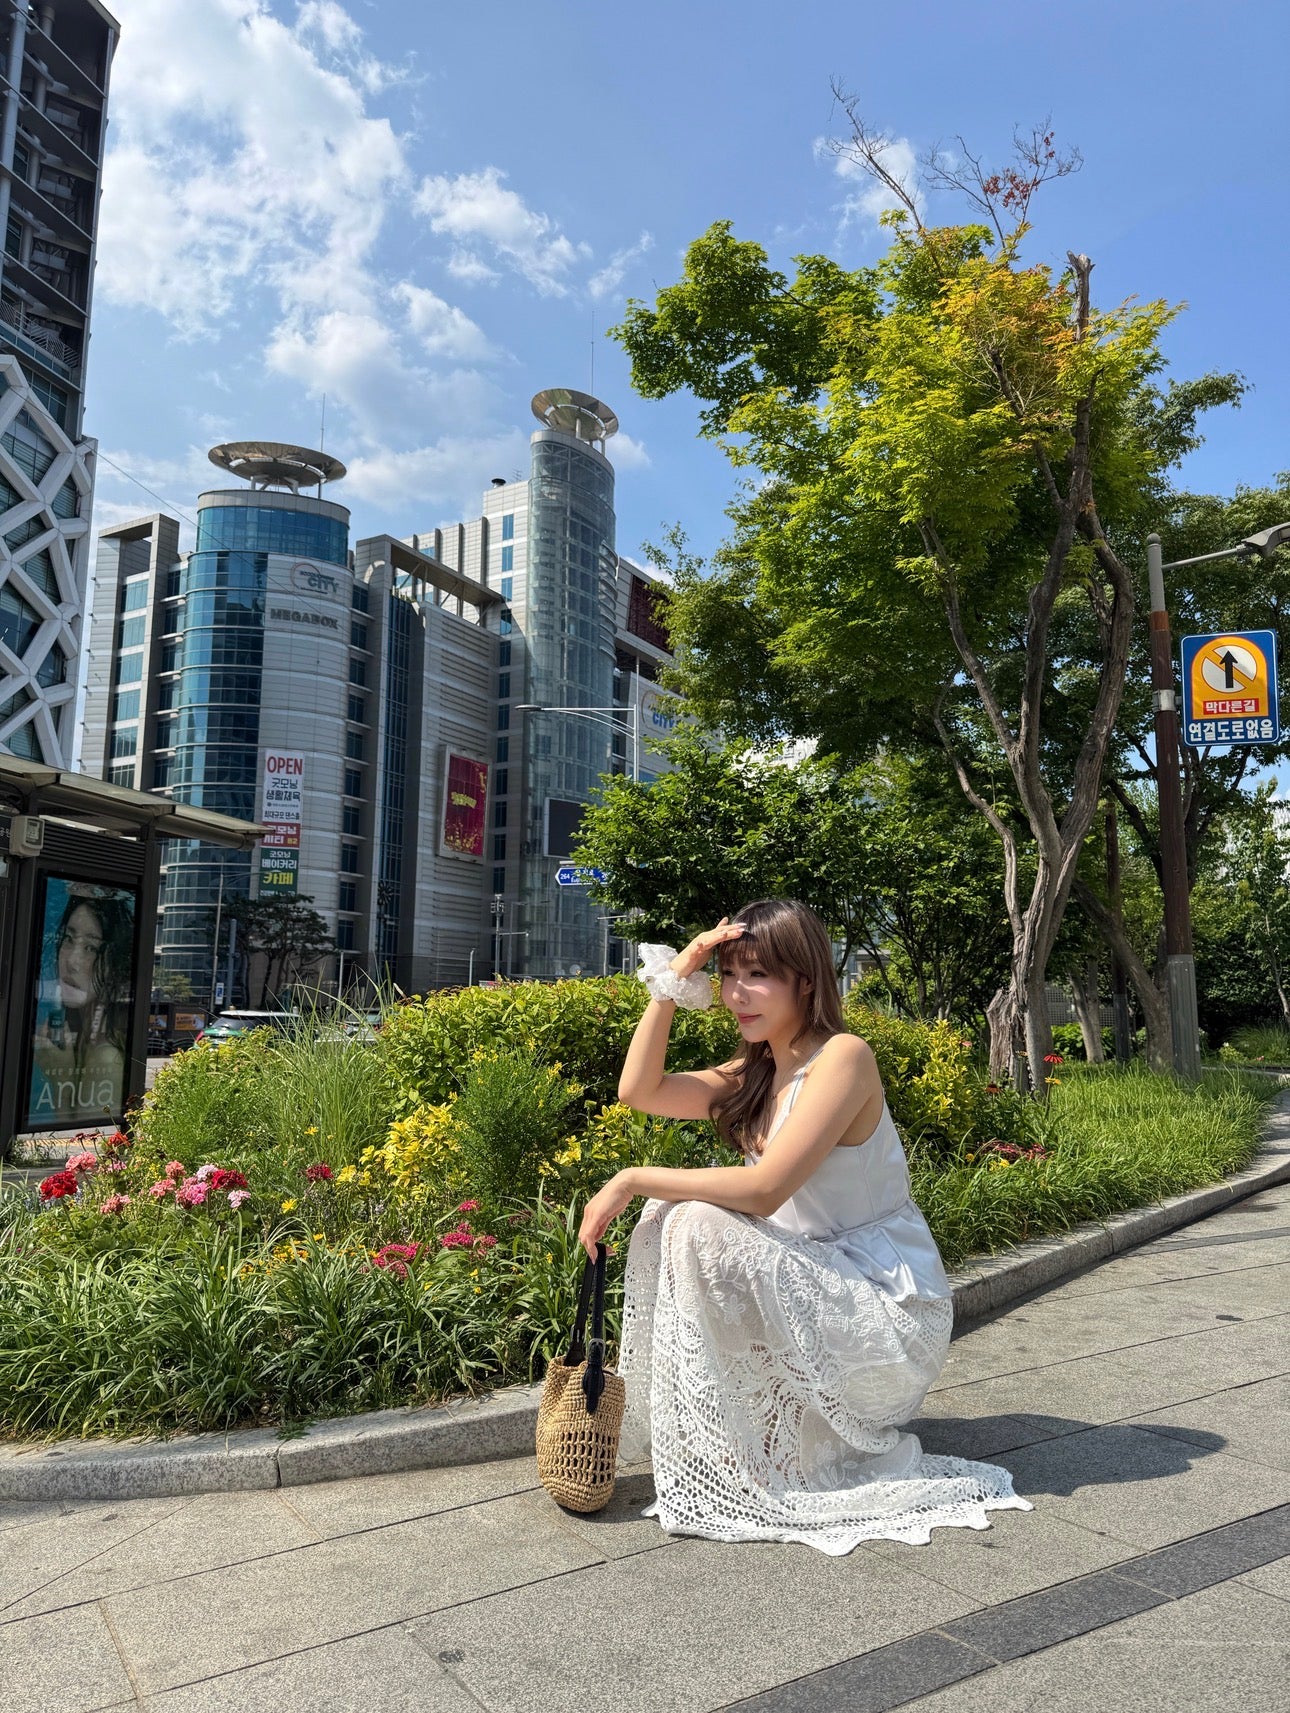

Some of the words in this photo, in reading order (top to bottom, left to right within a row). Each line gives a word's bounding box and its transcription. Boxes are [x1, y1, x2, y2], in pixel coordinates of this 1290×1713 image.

[307, 576, 340, 593] CITY
[270, 607, 339, 630] MEGABOX
[1205, 699, 1256, 714] 막다른길
[1188, 719, 1274, 742] 연결도로없음
[267, 756, 303, 775] OPEN
[272, 777, 298, 789] 굿모닝
[266, 789, 301, 802] 생활체육
[264, 834, 284, 845] 시티
[261, 858, 297, 870] 베이커리
[262, 871, 294, 885] 카페
[35, 1079, 115, 1110] Anua
